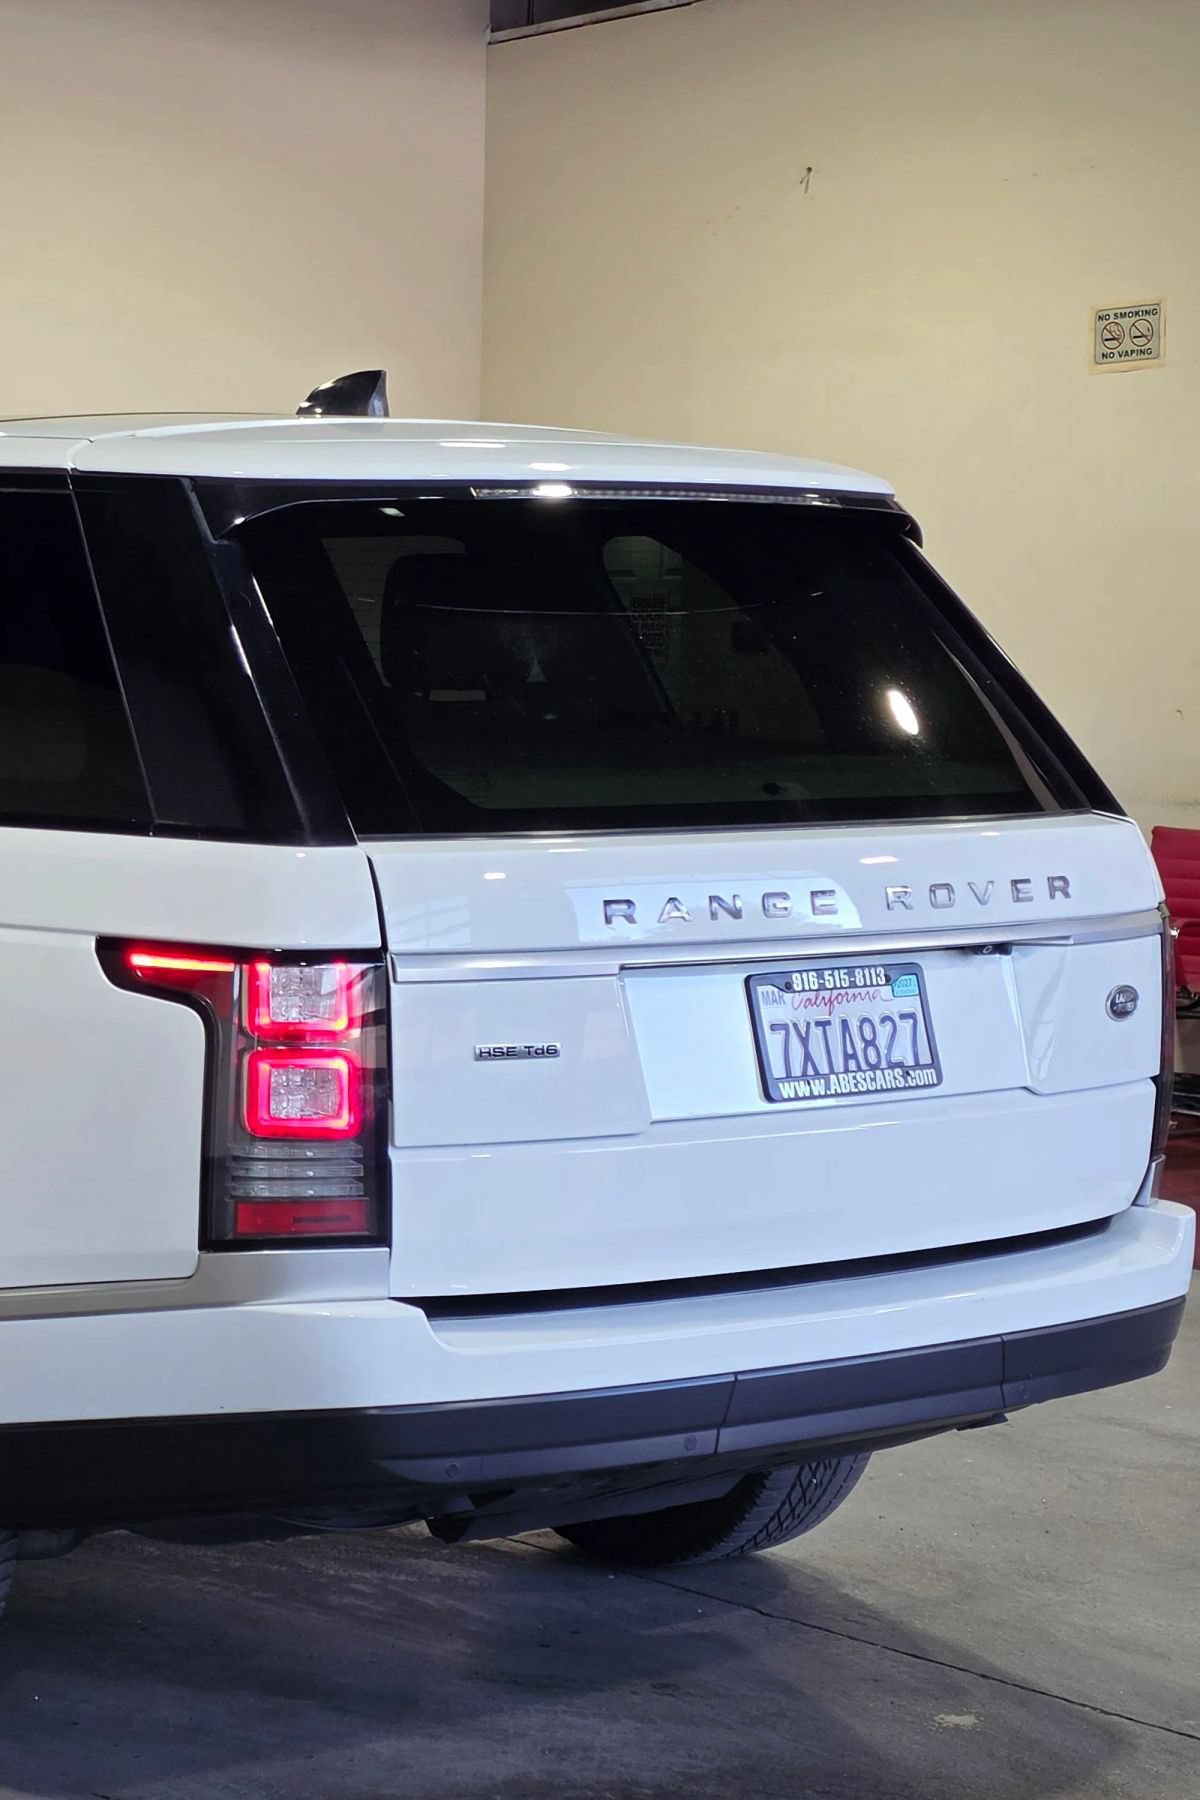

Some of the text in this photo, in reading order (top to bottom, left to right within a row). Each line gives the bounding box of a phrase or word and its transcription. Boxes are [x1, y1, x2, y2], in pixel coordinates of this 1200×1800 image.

[1097, 308, 1158, 322] NO SMOKING
[1101, 348, 1152, 360] NO VAPING
[602, 876, 1072, 925] RANGE ROVER
[792, 967, 886, 991] 916-515-8113
[761, 990, 786, 1006] MAR
[791, 989, 880, 1016] California
[479, 1044, 558, 1058] HSE Td6
[770, 1011, 920, 1078] 7XTA827
